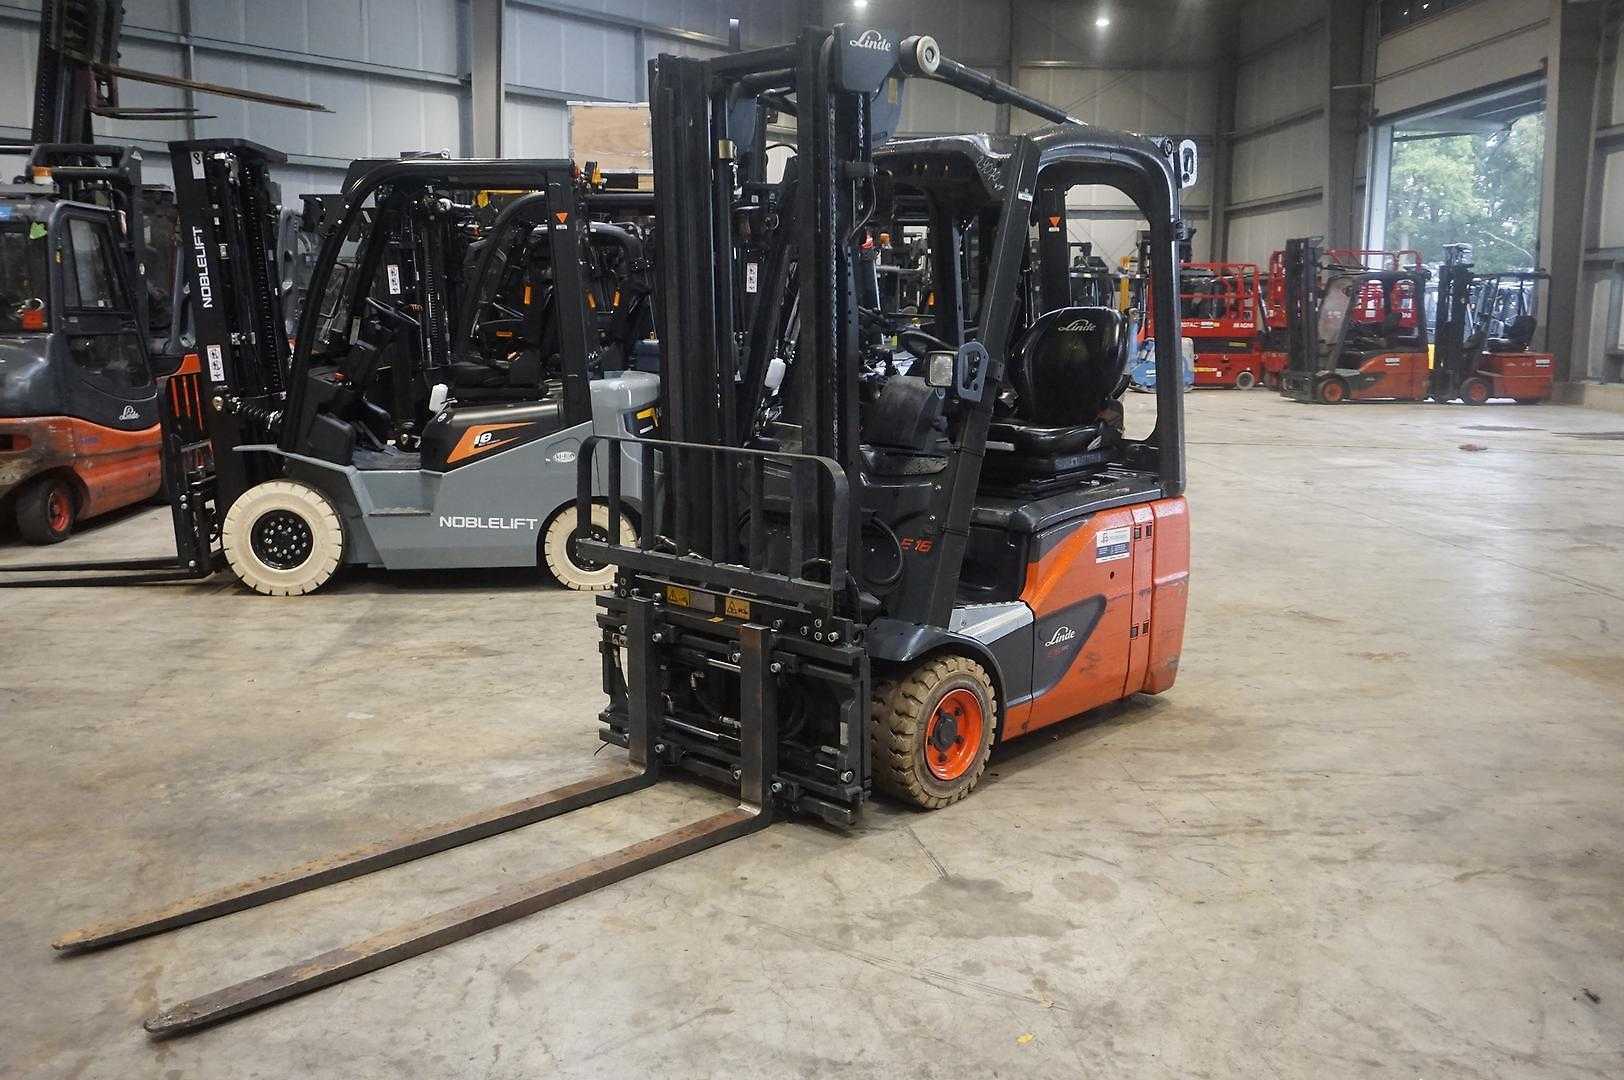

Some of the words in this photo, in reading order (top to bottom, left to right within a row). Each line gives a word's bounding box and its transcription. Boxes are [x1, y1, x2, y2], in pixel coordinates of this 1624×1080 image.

[849, 29, 893, 52] Linde
[192, 226, 213, 308] NOBLELIFT
[1057, 319, 1097, 332] Linde
[474, 432, 492, 446] 18
[439, 516, 538, 530] NOBLELIFT
[1045, 626, 1076, 647] Linde
